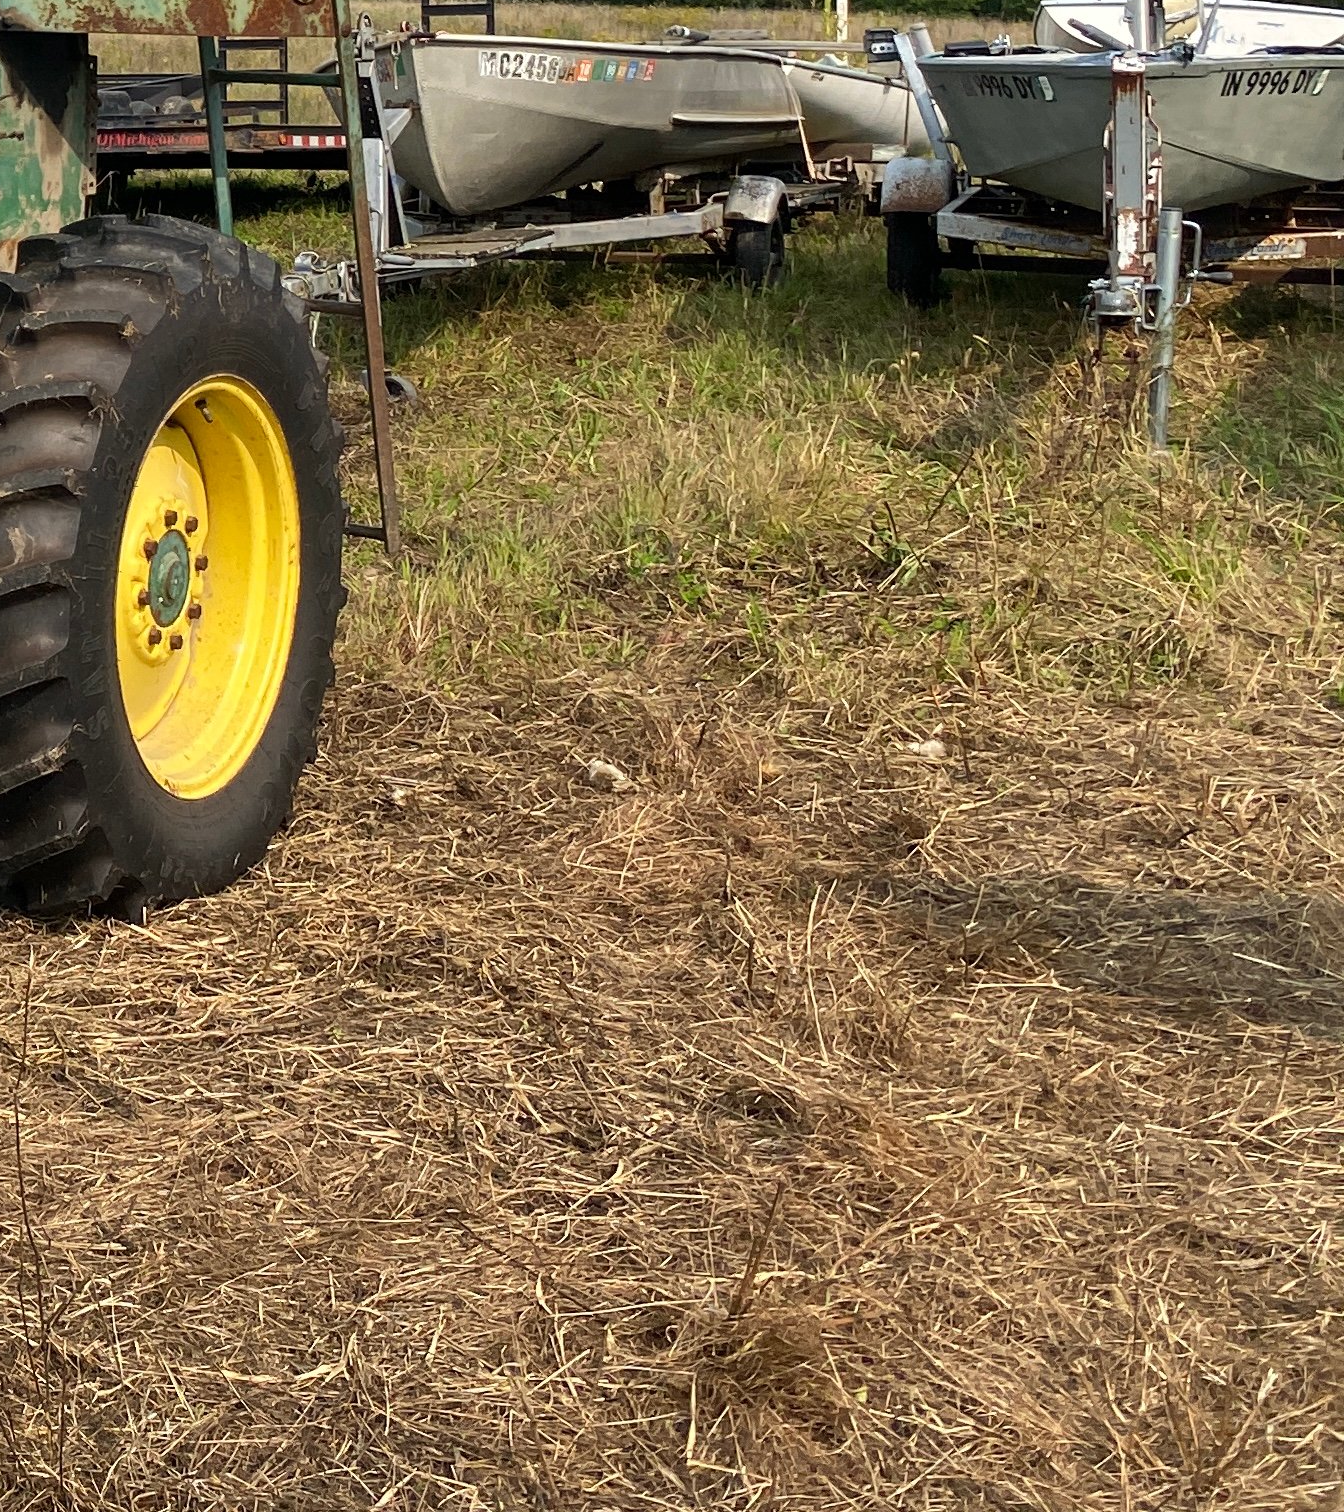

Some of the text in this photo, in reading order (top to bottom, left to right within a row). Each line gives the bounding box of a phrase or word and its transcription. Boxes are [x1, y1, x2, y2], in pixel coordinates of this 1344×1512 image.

[1221, 69, 1318, 96] IN 9996 DY
